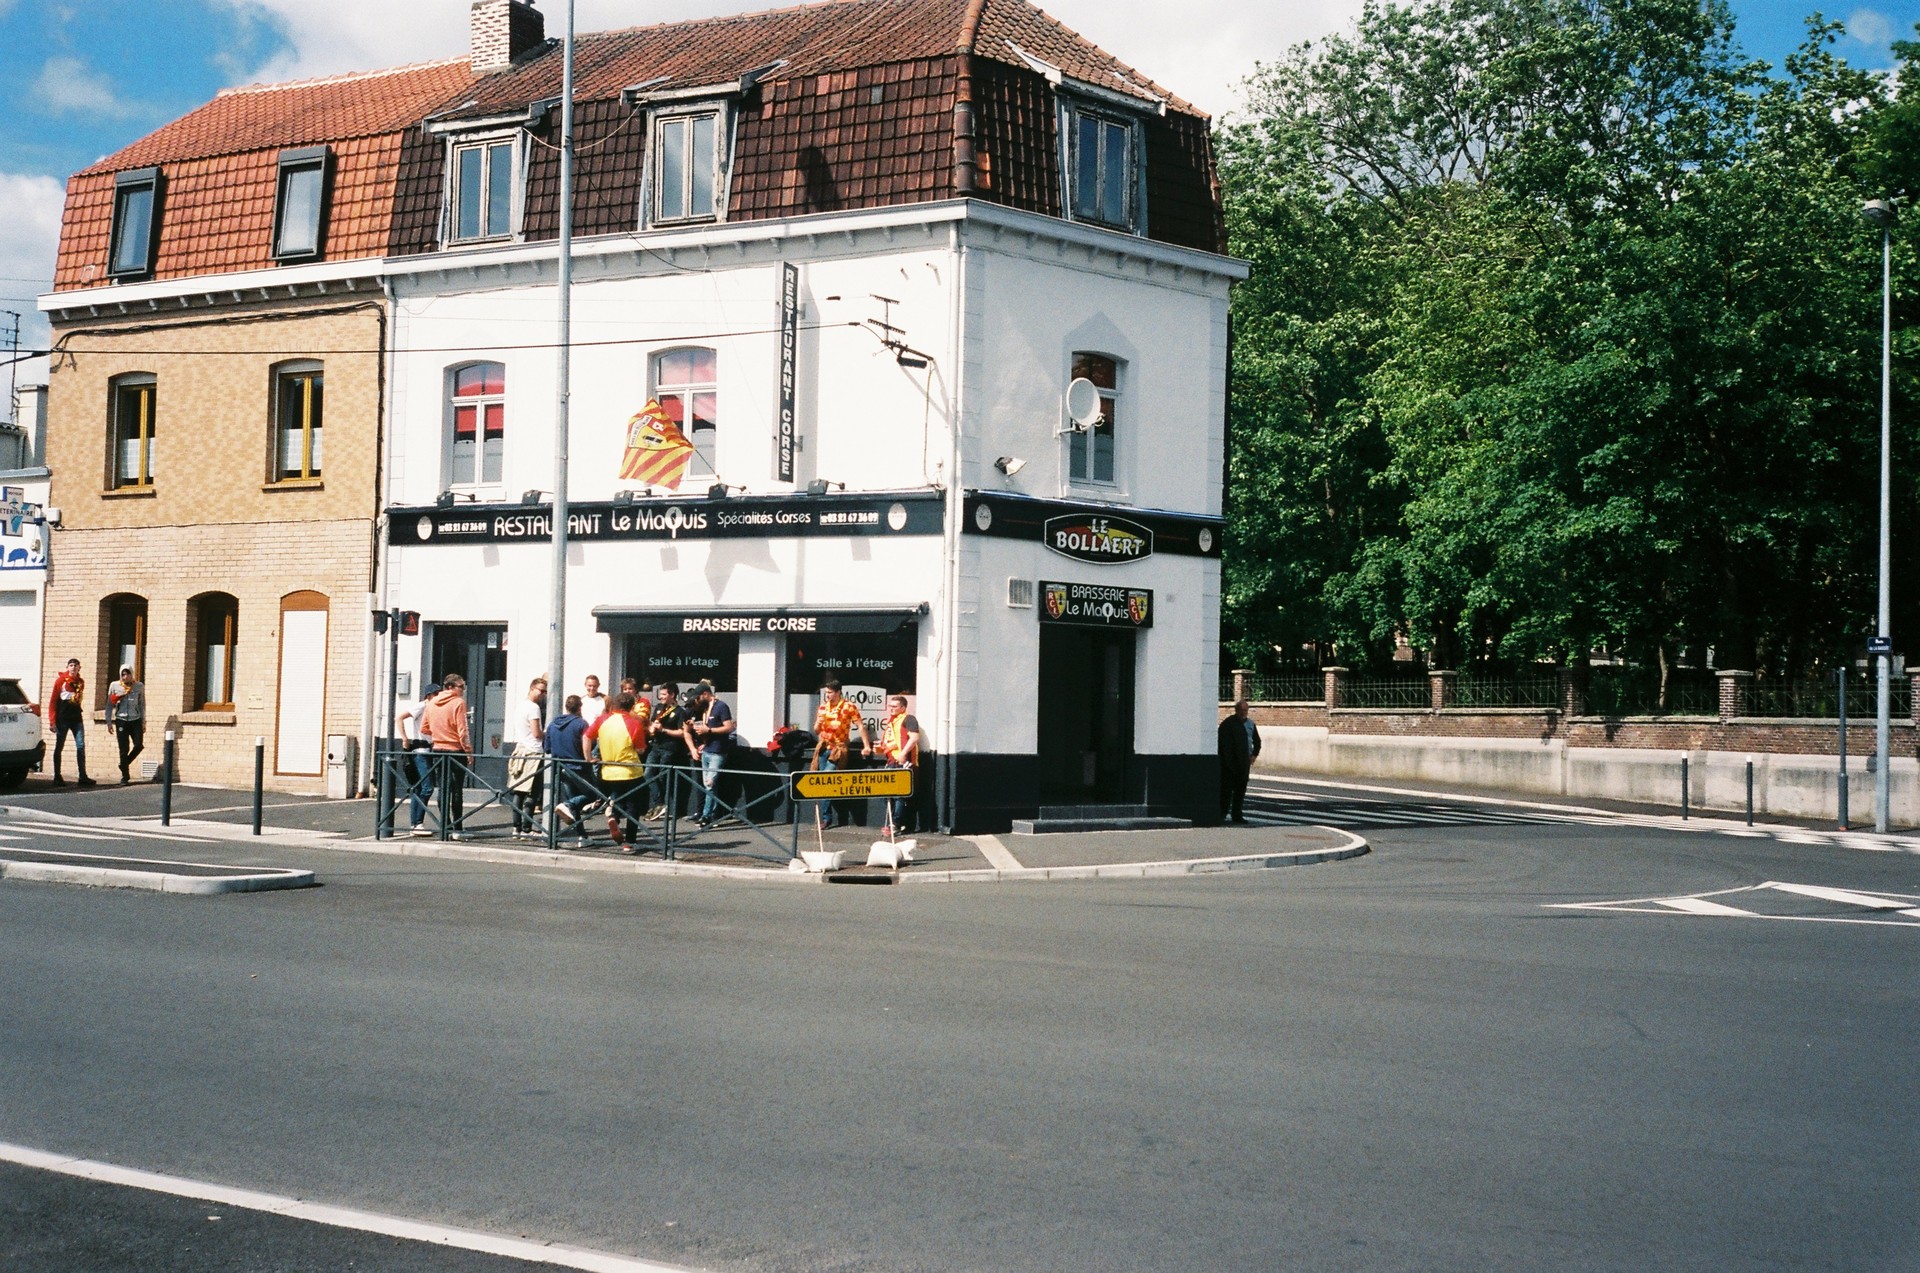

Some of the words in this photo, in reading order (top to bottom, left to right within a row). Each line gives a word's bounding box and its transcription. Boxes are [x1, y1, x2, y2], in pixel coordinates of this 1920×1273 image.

[782, 268, 795, 401] RESTAURANT
[781, 409, 792, 475] CORSE
[494, 513, 602, 536] RESTAUANT
[611, 510, 631, 531] Le
[717, 509, 772, 527] Spécialités
[775, 510, 811, 524] Corses
[1091, 518, 1109, 534] LE
[1056, 531, 1143, 555] BOLLAERT
[1071, 585, 1125, 602] BRASSERIE
[1066, 600, 1080, 615] Le
[683, 617, 761, 632] BRASSERIE
[767, 617, 816, 631] CORSE
[649, 657, 673, 666] Salle
[675, 656, 682, 666] à
[816, 658, 843, 668] Salle
[845, 657, 852, 668] à
[855, 657, 893, 670] l'étage
[809, 776, 843, 786] CALAIS
[852, 773, 896, 785] BÉTHUNE
[840, 785, 872, 795] LIÉVIN
